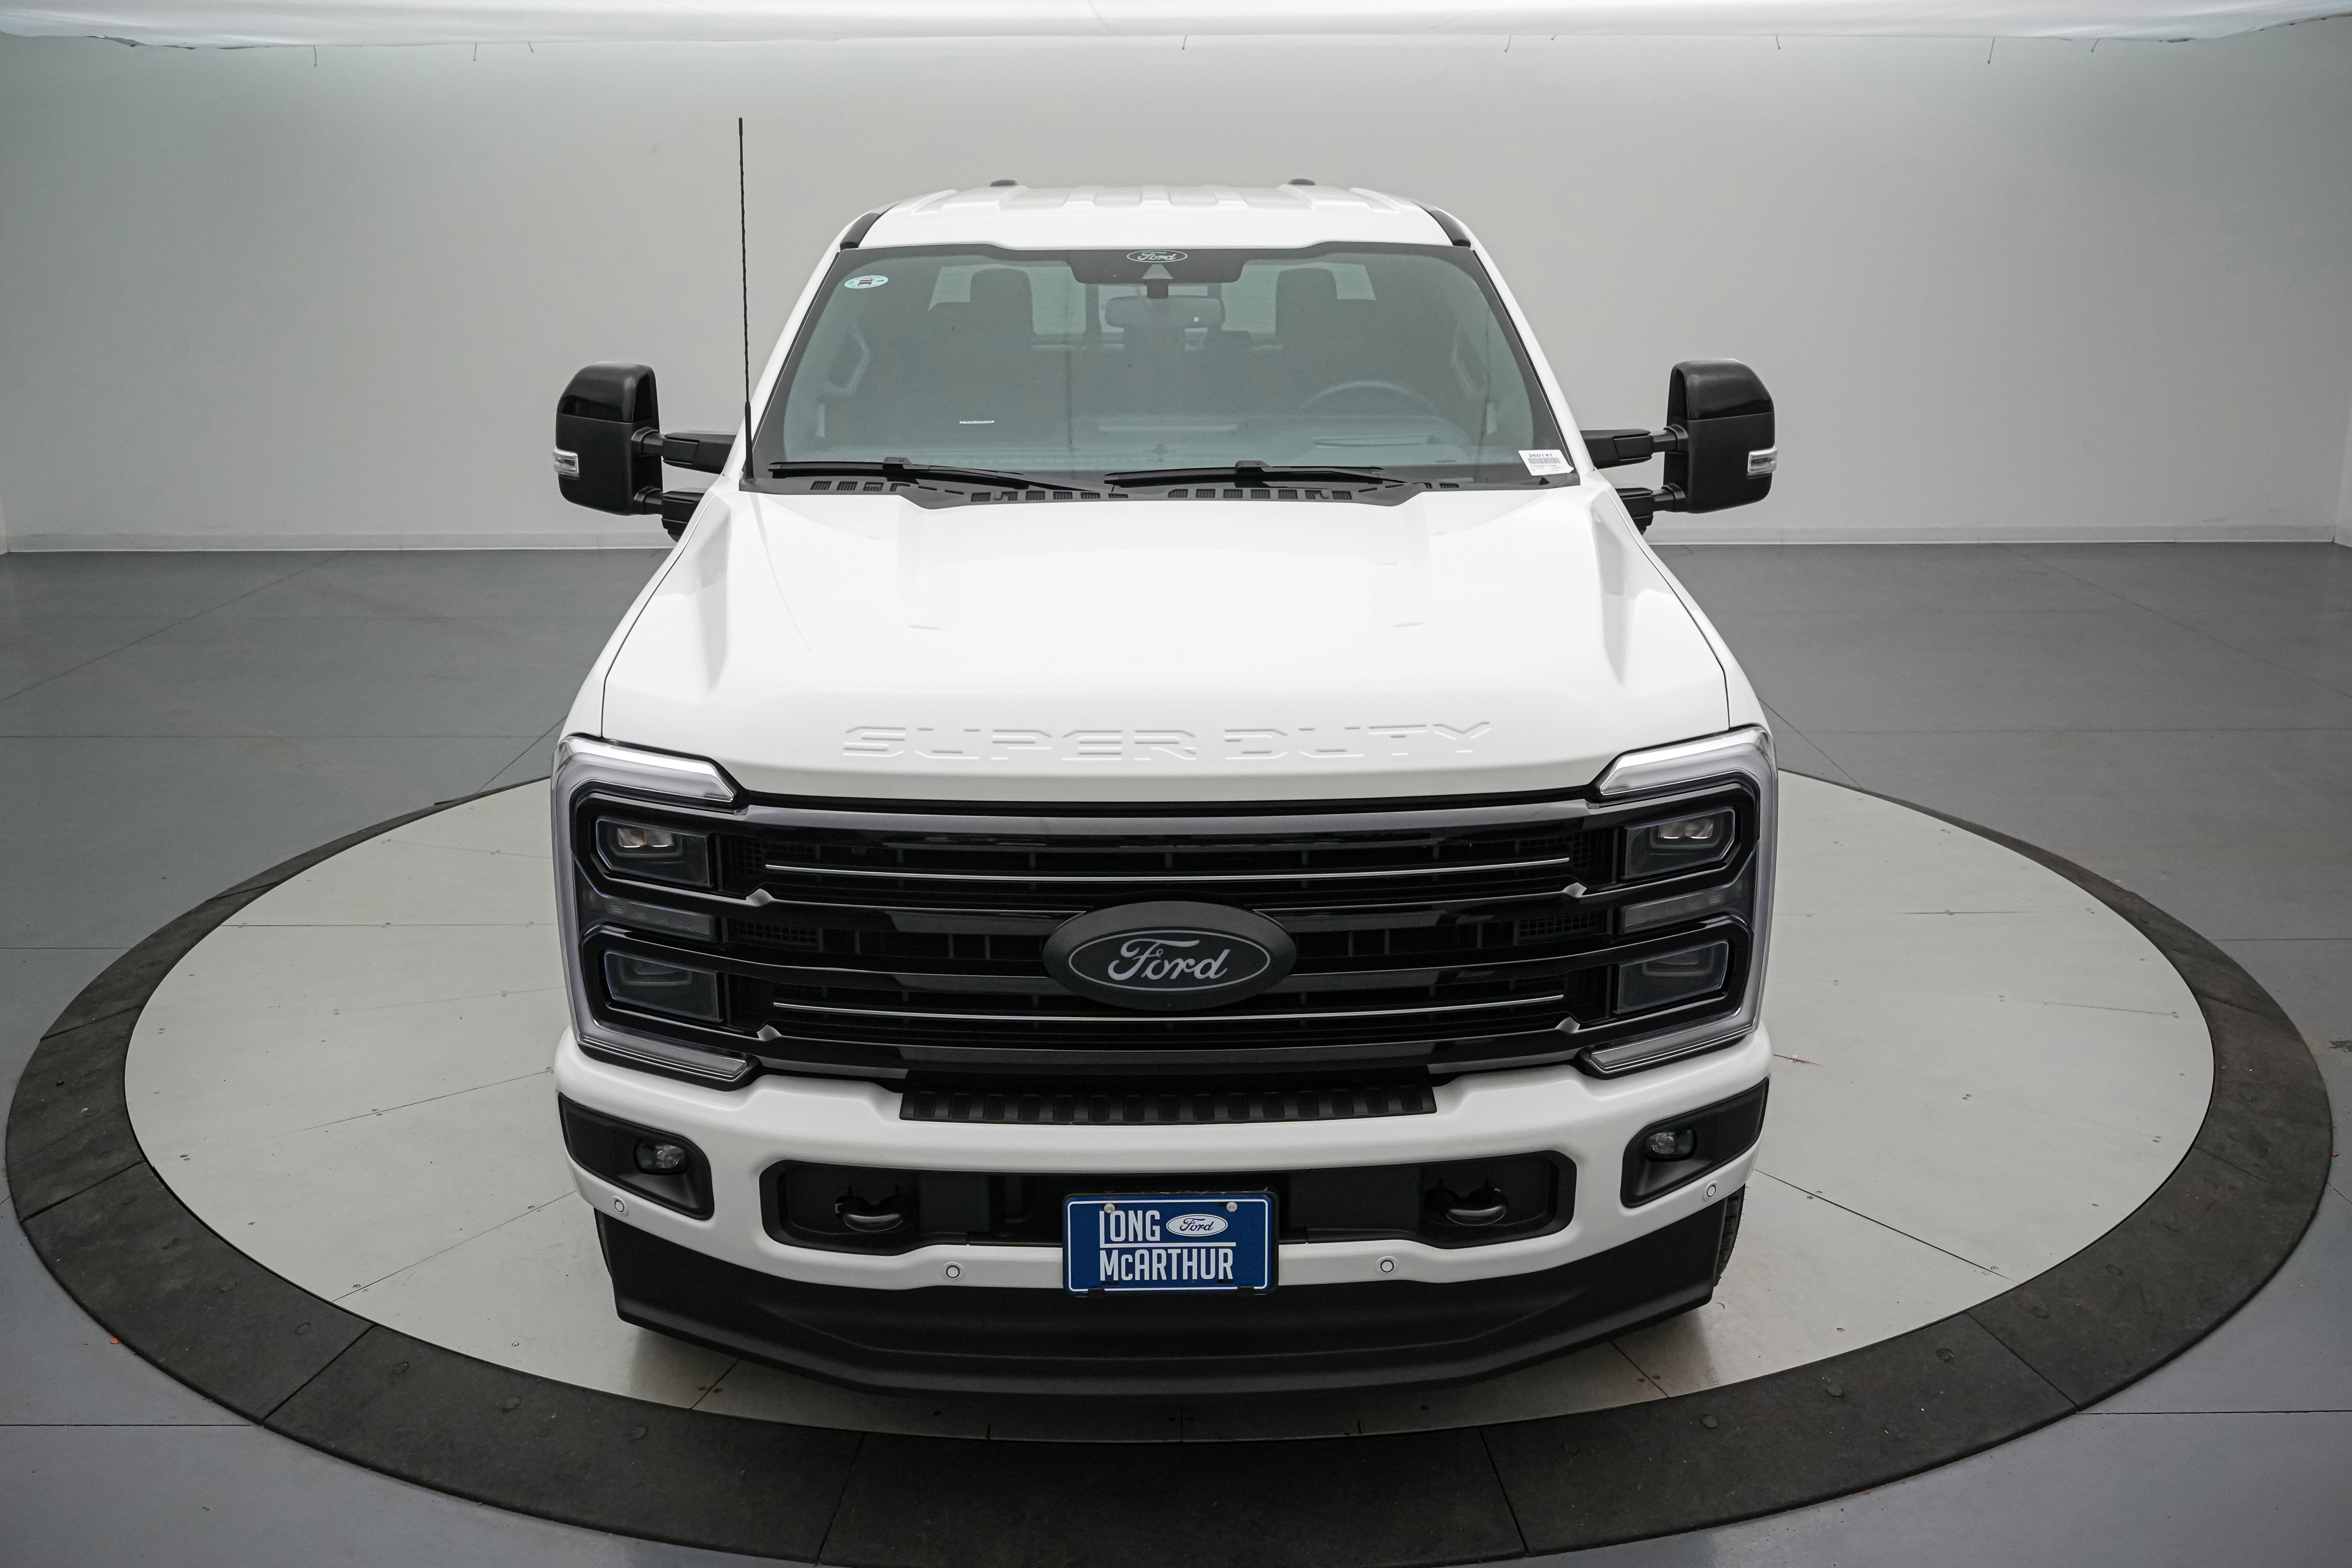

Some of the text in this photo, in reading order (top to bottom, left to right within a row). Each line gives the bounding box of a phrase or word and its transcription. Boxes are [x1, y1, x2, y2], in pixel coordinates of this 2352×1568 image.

[1137, 251, 1176, 261] Ford
[842, 721, 1492, 761] SUPER DUTY
[1107, 938, 1231, 980] Ford
[1099, 1210, 1214, 1248] LONG Ford
